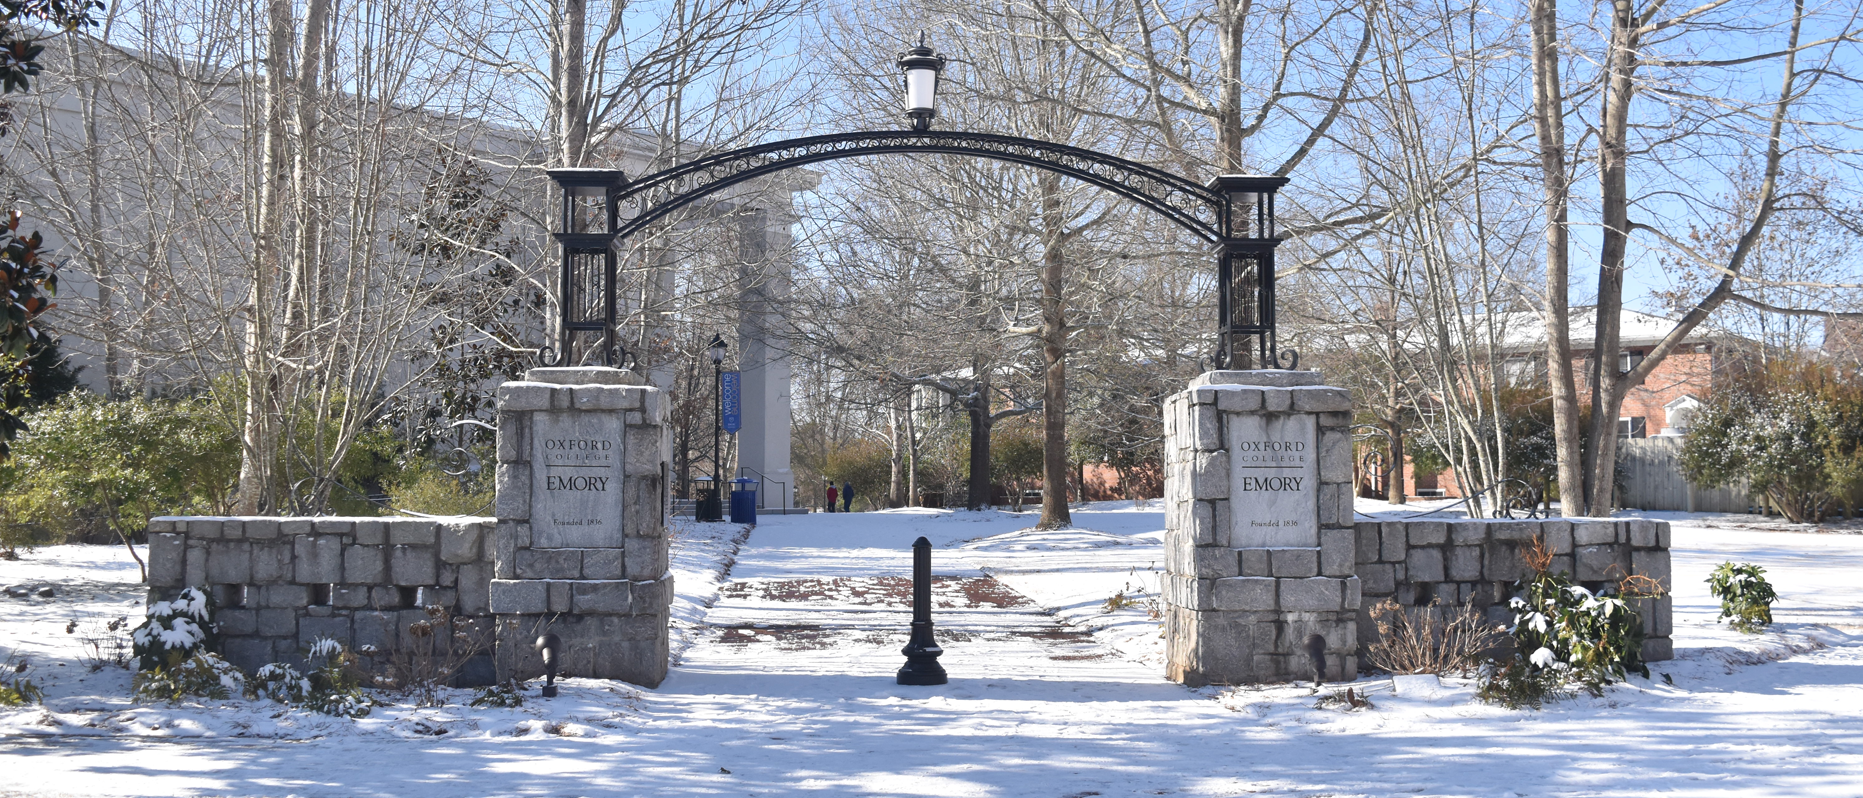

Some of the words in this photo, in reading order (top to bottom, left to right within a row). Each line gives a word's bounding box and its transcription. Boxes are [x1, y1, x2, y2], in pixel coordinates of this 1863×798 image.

[723, 373, 732, 415] welcome
[545, 439, 612, 451] OXFORD
[1240, 441, 1305, 452] OXFORD
[545, 453, 611, 461] COLLEGE
[546, 475, 610, 492] EMORY
[1242, 476, 1304, 492] EMORY
[553, 518, 583, 526] Founded
[587, 518, 603, 526] 1836
[1250, 519, 1280, 527] Founded
[1283, 519, 1299, 527] 1836
